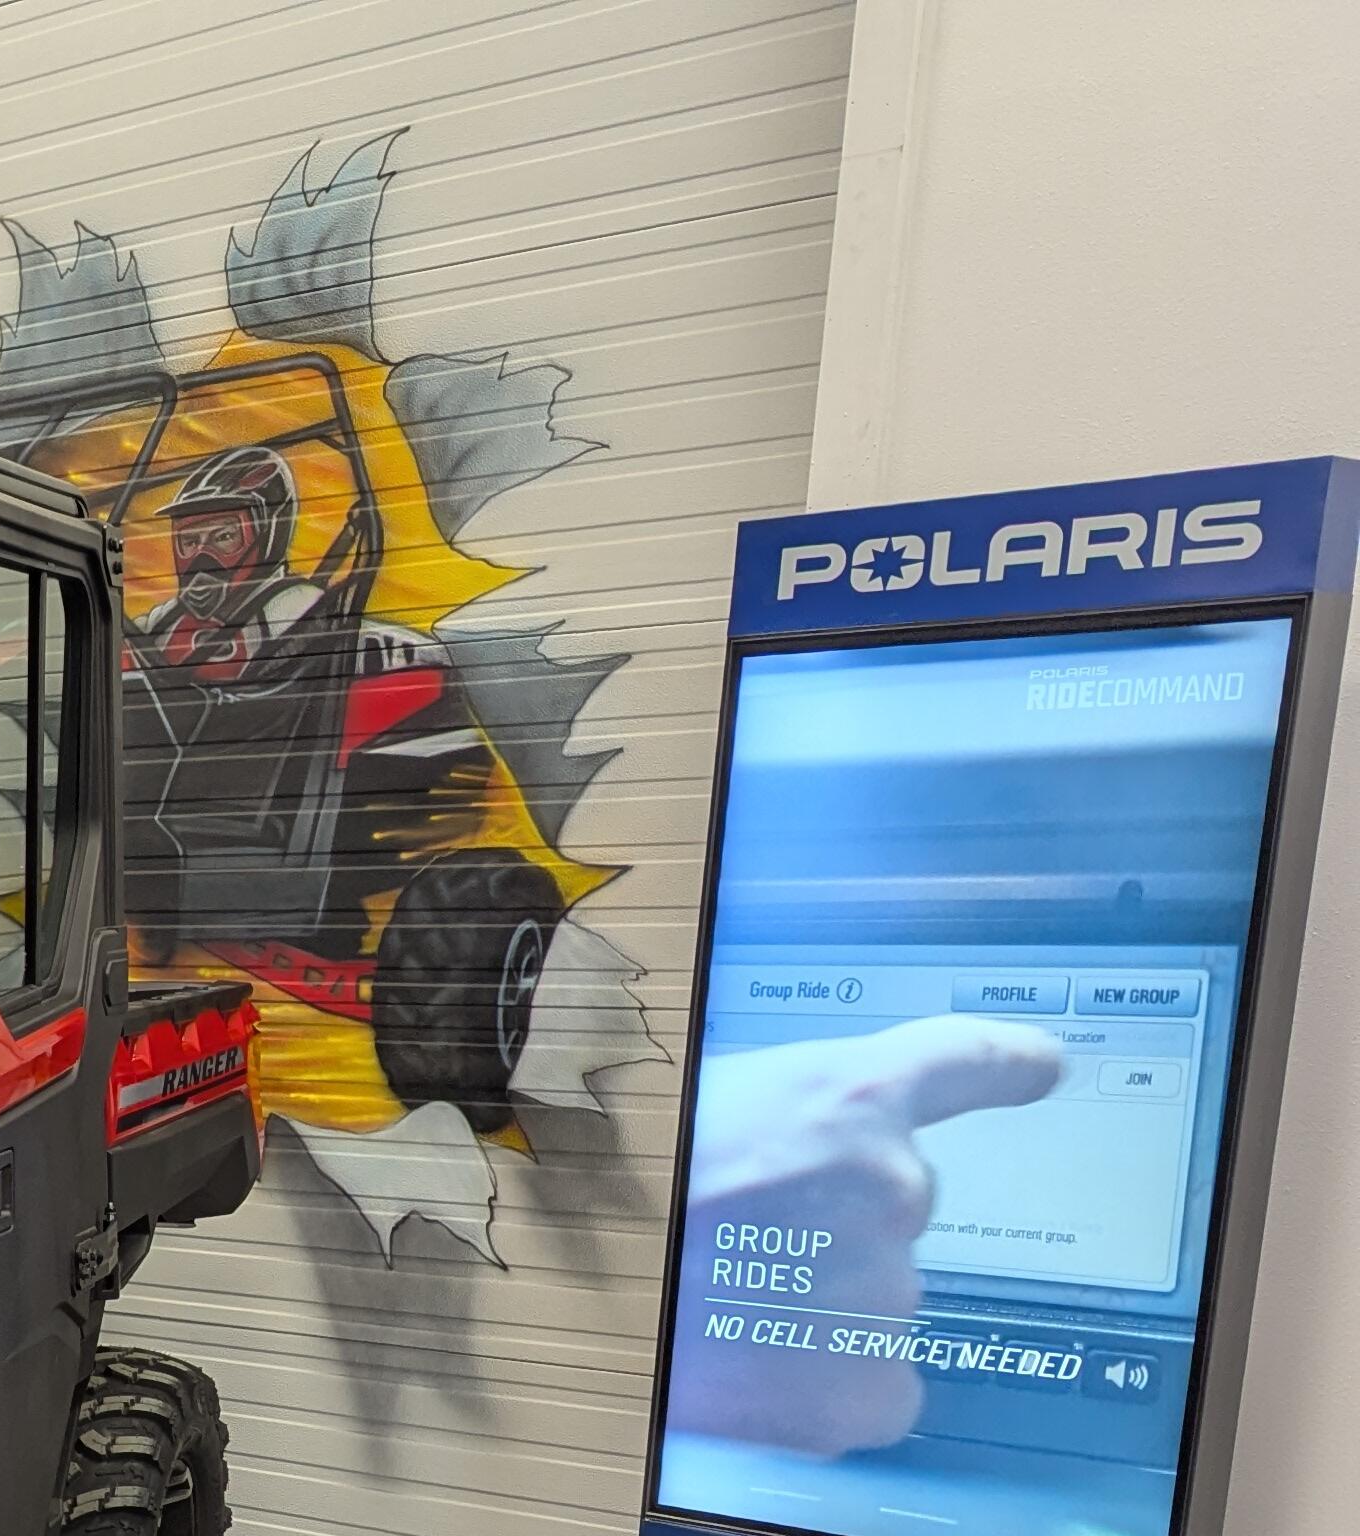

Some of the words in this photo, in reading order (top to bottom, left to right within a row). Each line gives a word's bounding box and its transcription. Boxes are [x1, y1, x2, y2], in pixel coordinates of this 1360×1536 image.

[777, 499, 1263, 601] POLARIS
[1030, 665, 1109, 680] POLARIS
[1026, 672, 1245, 711] RIDECOMMAND
[749, 981, 793, 1001] Group
[797, 981, 830, 999] Ride
[982, 986, 1038, 1002] PROFILE
[1093, 988, 1125, 1004] NEW
[1129, 988, 1180, 1005] GROUP
[161, 1045, 240, 1097] RANGER
[1126, 1072, 1153, 1086] JOIN
[715, 1222, 833, 1259] GROUP
[957, 1223, 978, 1235] with
[980, 1227, 1003, 1239] your
[1005, 1227, 1043, 1241] current
[712, 1258, 814, 1294] RIDES
[704, 1313, 745, 1341] NO
[751, 1319, 818, 1350] CELL
[827, 1328, 952, 1365] SERVICE
[956, 1342, 1083, 1381] NEEDED
